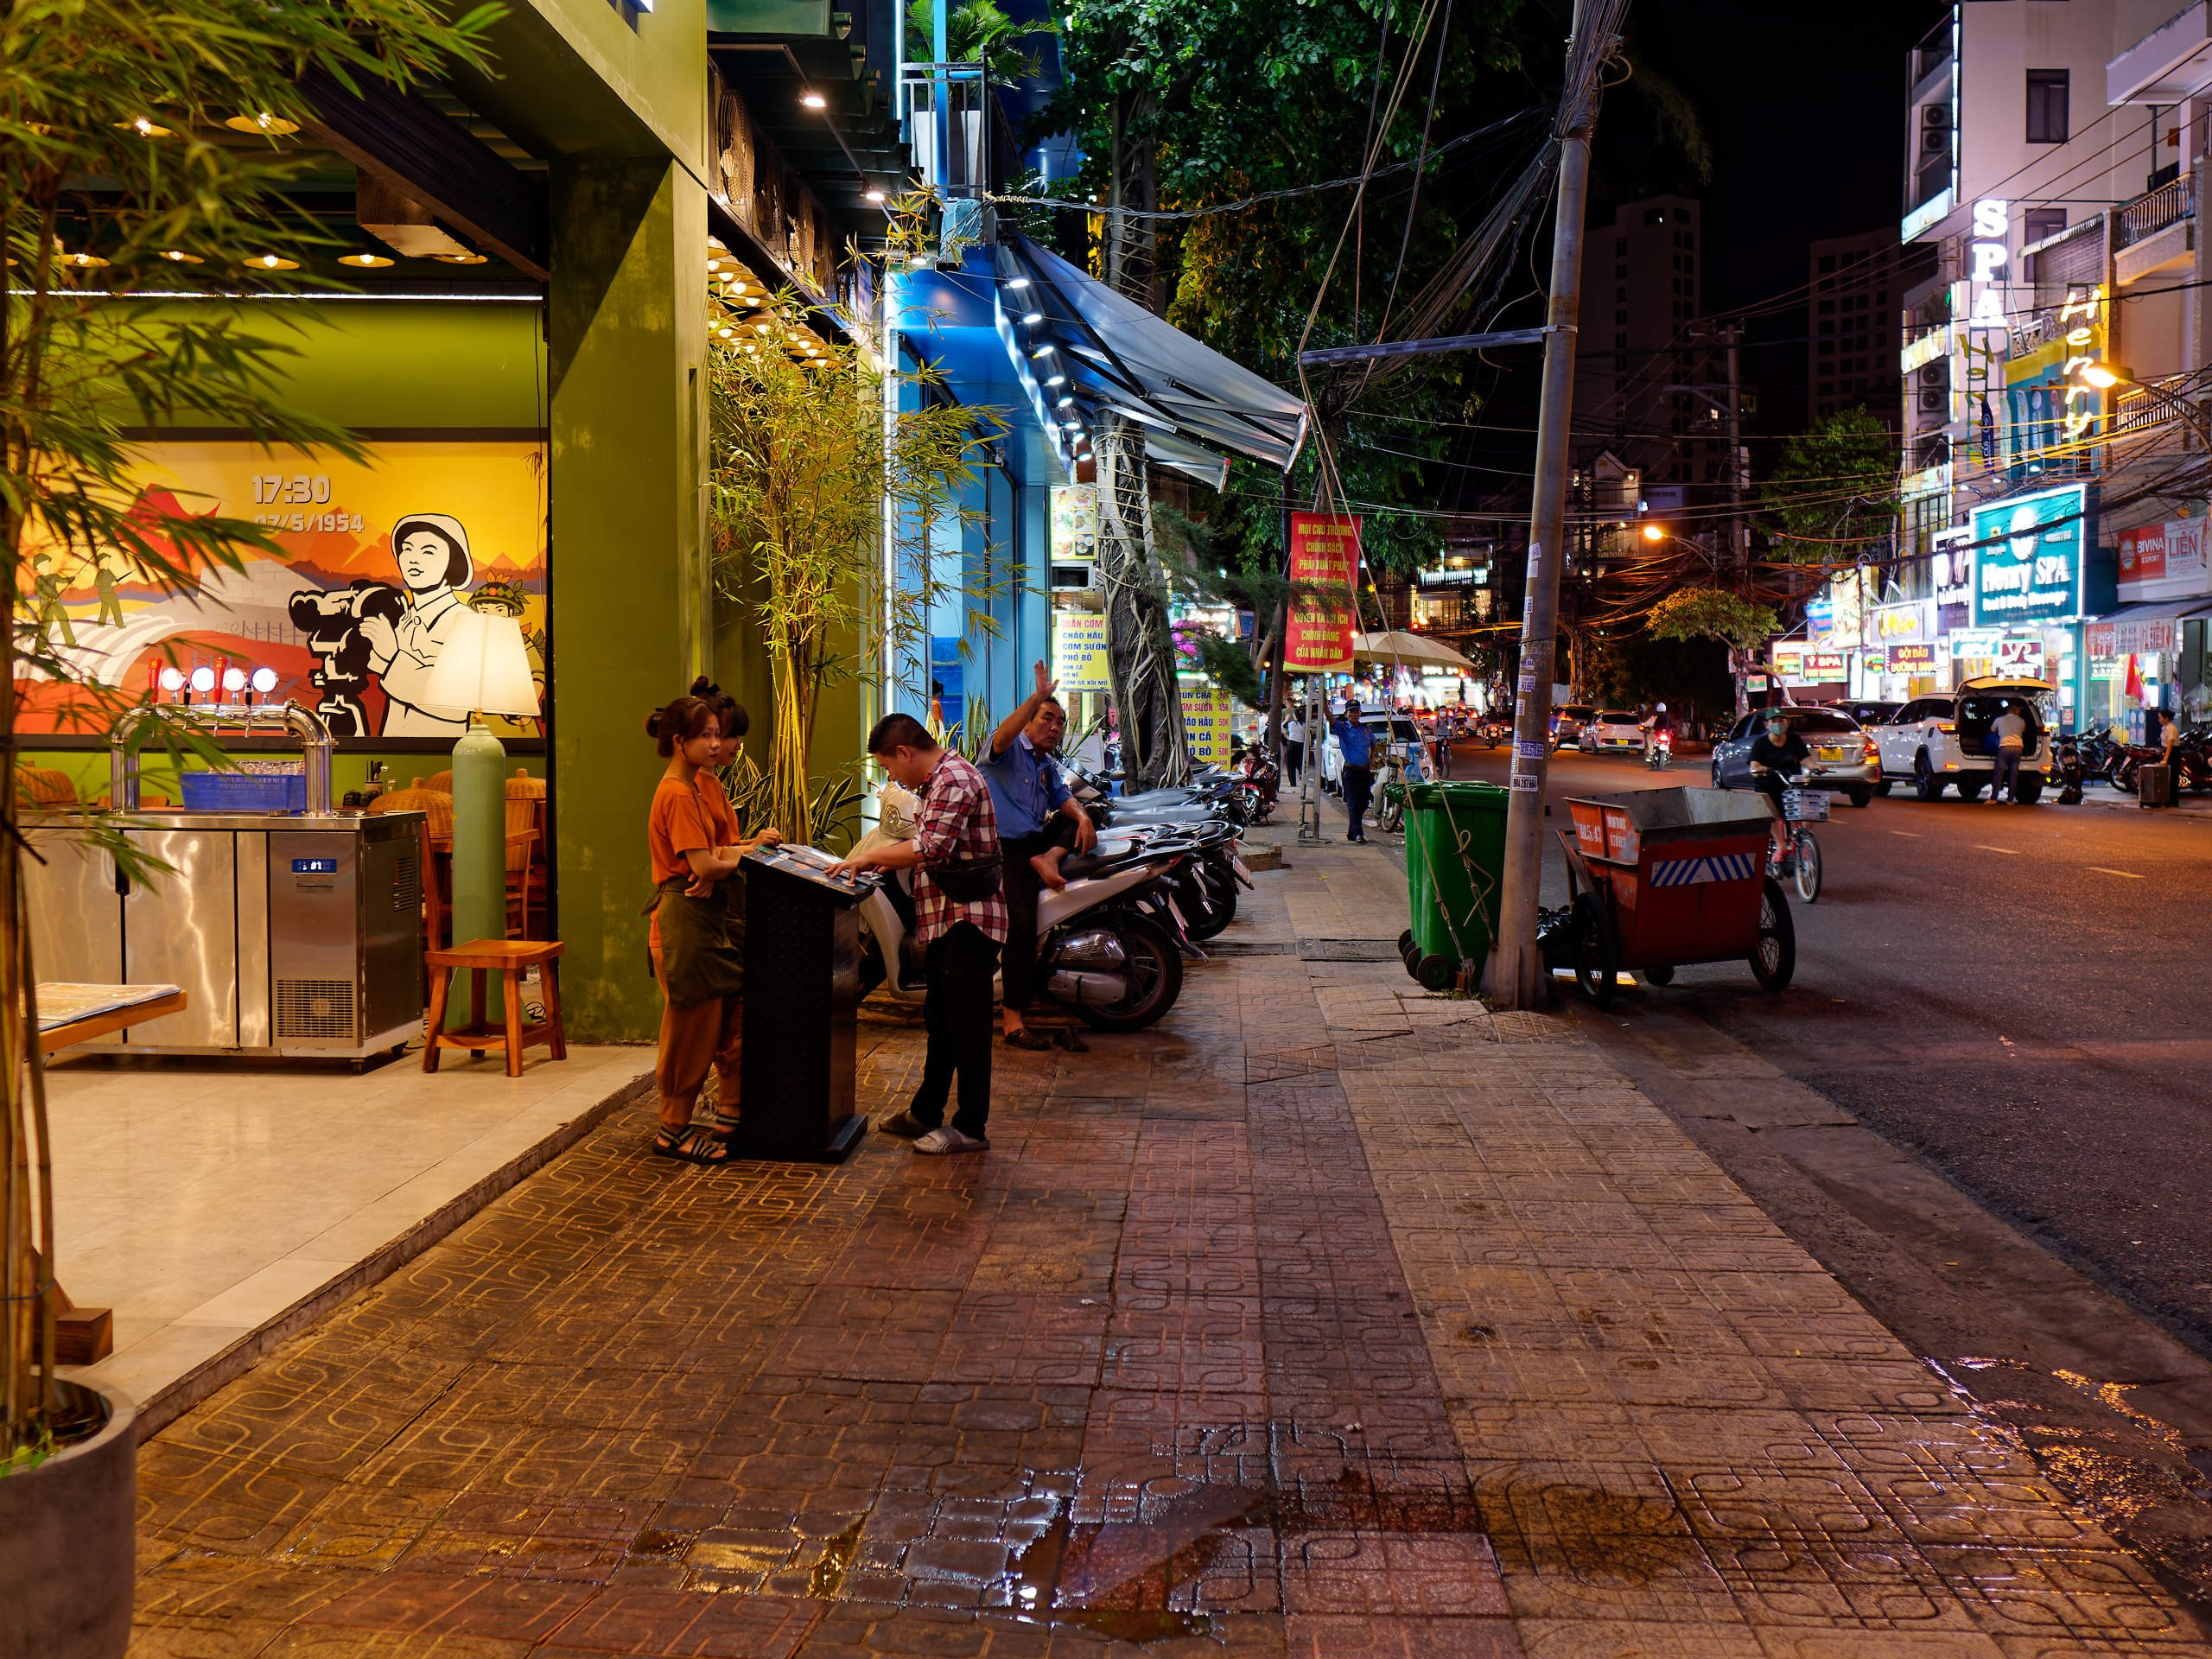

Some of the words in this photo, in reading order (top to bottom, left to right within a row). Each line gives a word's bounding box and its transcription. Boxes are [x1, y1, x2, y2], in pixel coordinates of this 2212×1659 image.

[1970, 199, 2008, 328] SPA
[2060, 288, 2101, 439] Henry
[253, 475, 331, 505] 17:30
[1299, 524, 1311, 537] MỌI
[1313, 521, 1325, 535] CHỦ
[1306, 540, 1326, 553] CHÍNH
[2137, 537, 2164, 554] BIVINA
[2168, 531, 2198, 557] LIÊN
[1299, 556, 1314, 570] PHẢI
[2141, 554, 2160, 564] EXPORT
[1982, 563, 2033, 594] Henry
[2034, 554, 2071, 585] SPA
[1084, 619, 1103, 629] CƠM
[1338, 611, 1349, 625] ÍCH
[1301, 628, 1321, 641] CHÍNH
[1063, 652, 1079, 662] PHỞ
[1081, 653, 1092, 662] BÒ
[1296, 644, 1309, 658] CỦA
[1310, 646, 1328, 658] NHÂN
[1329, 646, 1344, 659] DÂN
[1817, 656, 1842, 667] SPA
[1181, 702, 1192, 712] ƠM
[1194, 701, 1213, 712] SƯỜN
[1184, 716, 1196, 727] ÁO
[1198, 716, 1213, 727] HÀU
[1218, 718, 1229, 727] 50K
[1198, 731, 1211, 741] CÁ
[1218, 733, 1229, 741] 50K
[1198, 745, 1211, 756] BÒ
[1217, 747, 1229, 756] 50K
